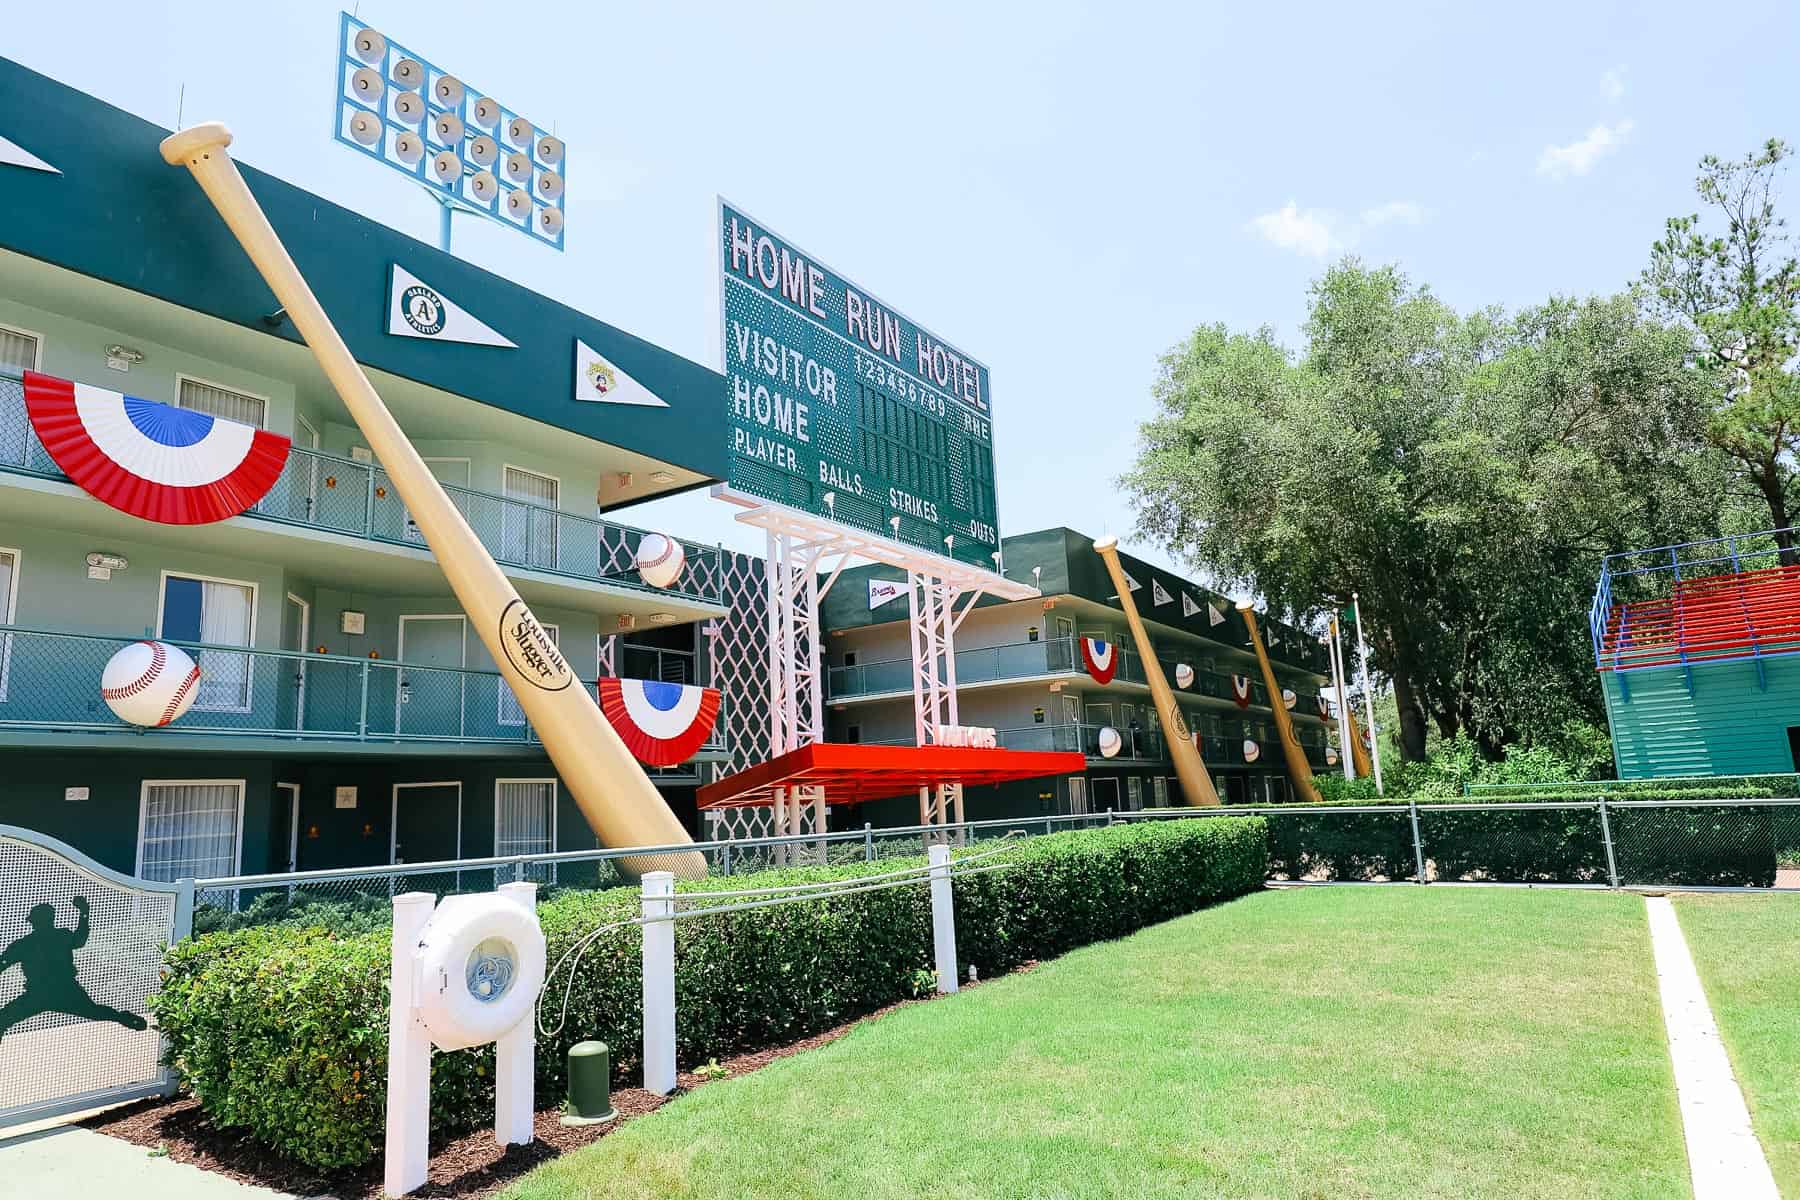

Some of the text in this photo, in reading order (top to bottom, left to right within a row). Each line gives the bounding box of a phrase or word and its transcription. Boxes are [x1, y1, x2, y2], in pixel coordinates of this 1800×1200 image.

[405, 313, 441, 334] ATHLETICS
[407, 288, 441, 308] OAKLAND
[731, 217, 988, 412] HOME RUN HOTEL
[733, 320, 837, 407] VISITOR
[734, 374, 810, 443] HOME
[735, 427, 797, 472] PLAYER
[819, 460, 995, 545] BALLS STRIKES OUTS
[511, 622, 553, 678] Slugger
[520, 609, 567, 676] Louisville
